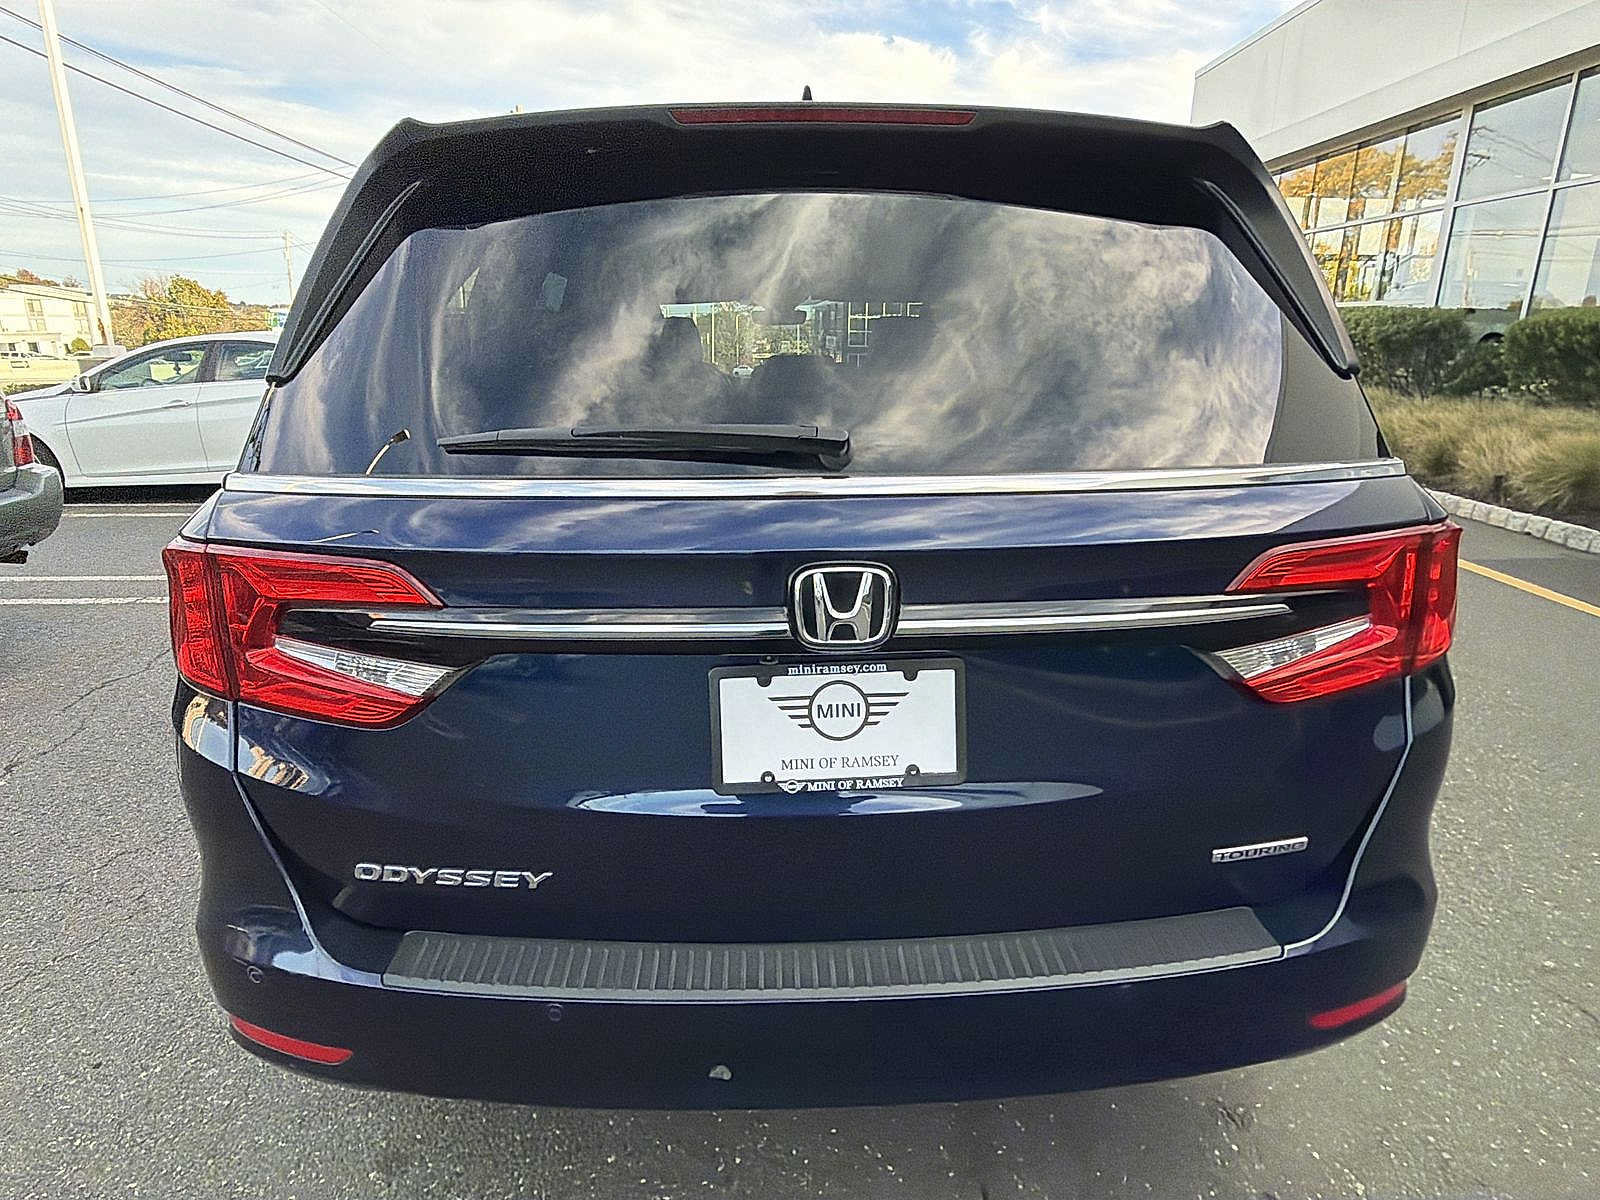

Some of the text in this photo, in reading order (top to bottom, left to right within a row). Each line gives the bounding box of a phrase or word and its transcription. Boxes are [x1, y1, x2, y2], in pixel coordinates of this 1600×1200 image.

[787, 663, 888, 676] miniramsey.com
[817, 702, 861, 719] MINI
[781, 754, 899, 770] MINI OF RAMSEY
[806, 780, 836, 792] MINI
[838, 780, 854, 790] OF
[856, 777, 905, 789] RAMSEY
[1214, 841, 1307, 861] TOURING
[354, 863, 553, 889] ODYSSEY
